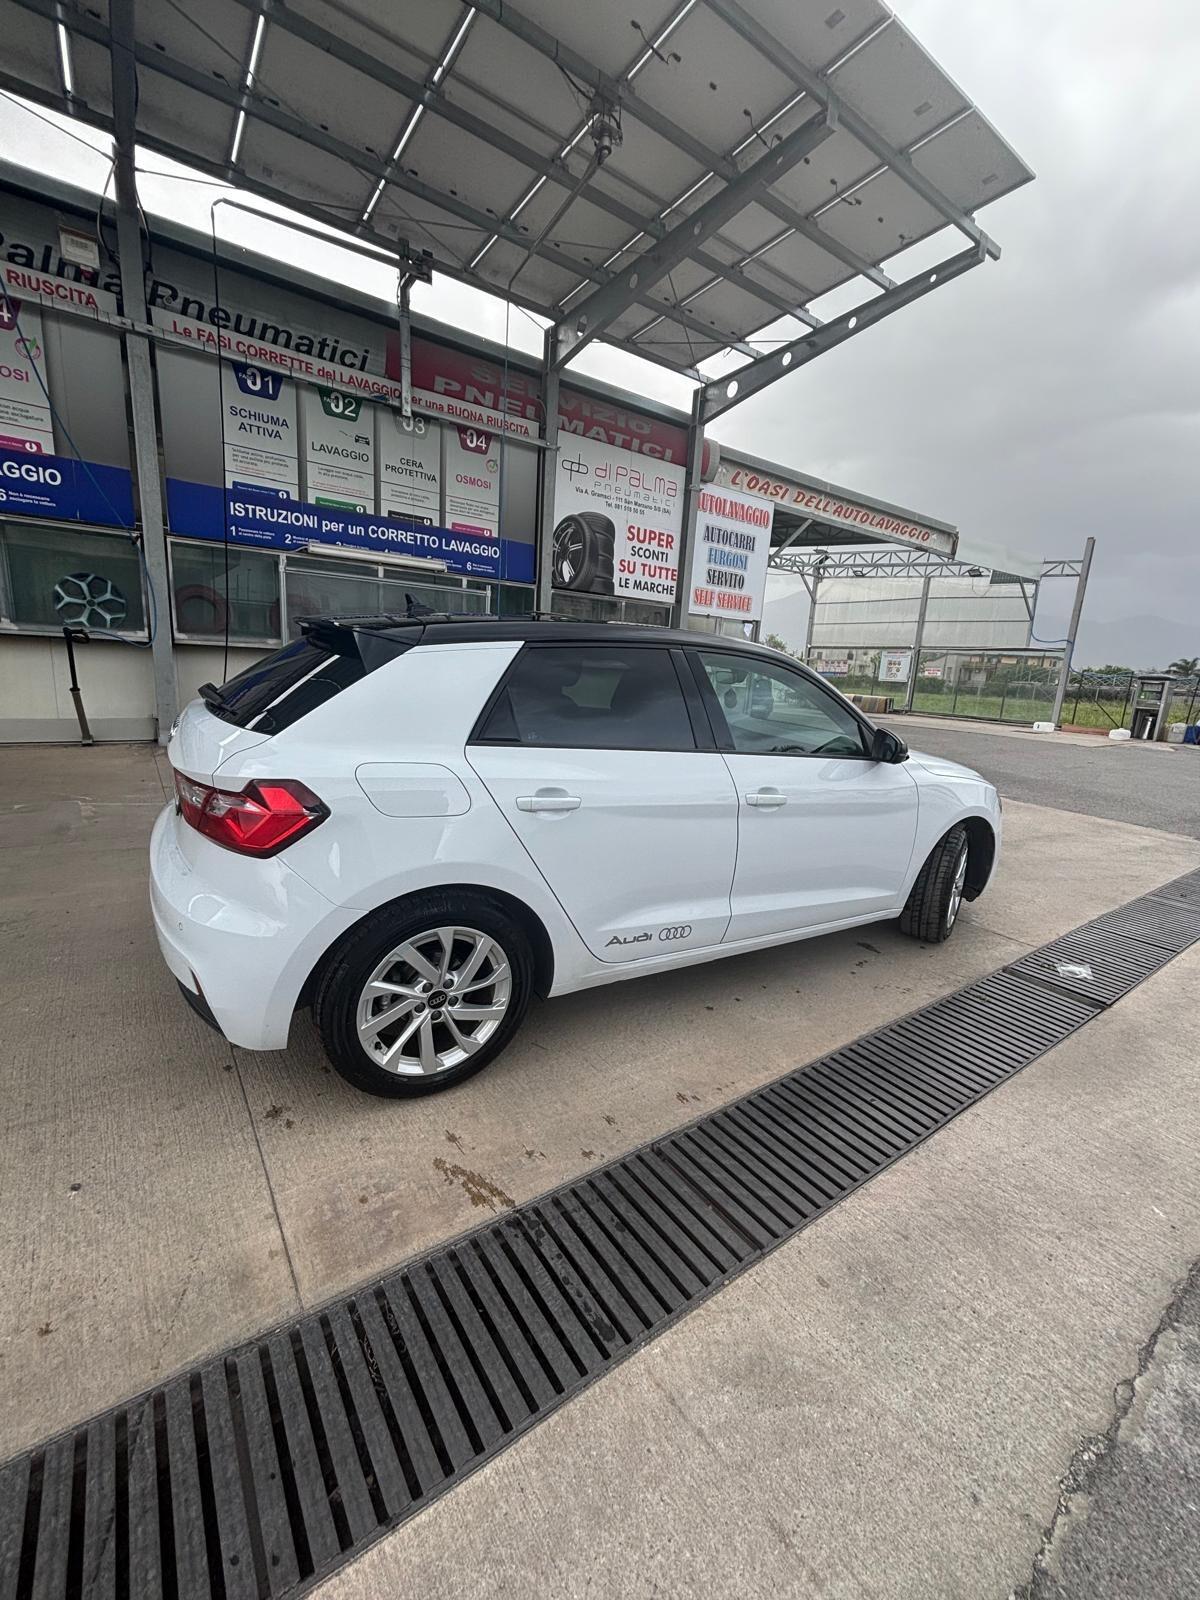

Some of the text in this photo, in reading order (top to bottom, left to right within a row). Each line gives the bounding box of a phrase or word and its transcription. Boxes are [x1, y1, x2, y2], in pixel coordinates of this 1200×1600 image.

[5, 268, 98, 309] RIUSCITA
[0, 231, 370, 371] alma Pneumatici
[172, 320, 192, 337] Le
[197, 328, 232, 350] FASI
[236, 341, 314, 374] CORRETTE
[317, 366, 336, 380] del
[340, 371, 402, 400] LAVAGGIO
[425, 401, 444, 412] una
[447, 404, 484, 423] BUONA
[487, 416, 530, 437] RIUSCITA
[247, 367, 273, 395] 01
[330, 391, 356, 417] 02
[230, 405, 290, 429] SCHIUMA
[238, 421, 283, 441] ATTIVA
[466, 428, 487, 451] 04
[311, 441, 370, 463] LAVAGGIO
[400, 457, 424, 470] CERA
[0, 461, 62, 486] GGIO
[385, 464, 437, 483] PROTETTIVA
[455, 473, 492, 490] OSMOSI
[731, 469, 790, 500] L'OASI
[793, 490, 931, 542] DELL'AUTOLAVAGGIO
[230, 501, 318, 529] ISTRUZIONI
[322, 519, 345, 533] per
[348, 524, 365, 536] un
[368, 525, 439, 549] CORRETTO
[442, 537, 500, 559] LAVAGGIO
[230, 525, 236, 536] 1
[284, 533, 292, 545] 2
[627, 524, 675, 550] SUPER
[704, 525, 756, 552] AUTOCARRI
[466, 561, 472, 571] 6
[630, 545, 669, 563] SCONTI
[708, 547, 749, 572] FURGONI
[619, 558, 678, 582] SU TUTTE
[707, 568, 745, 590] SERVITO
[619, 577, 675, 595] LE MARCHE
[694, 588, 753, 613] SELF SERVICE
